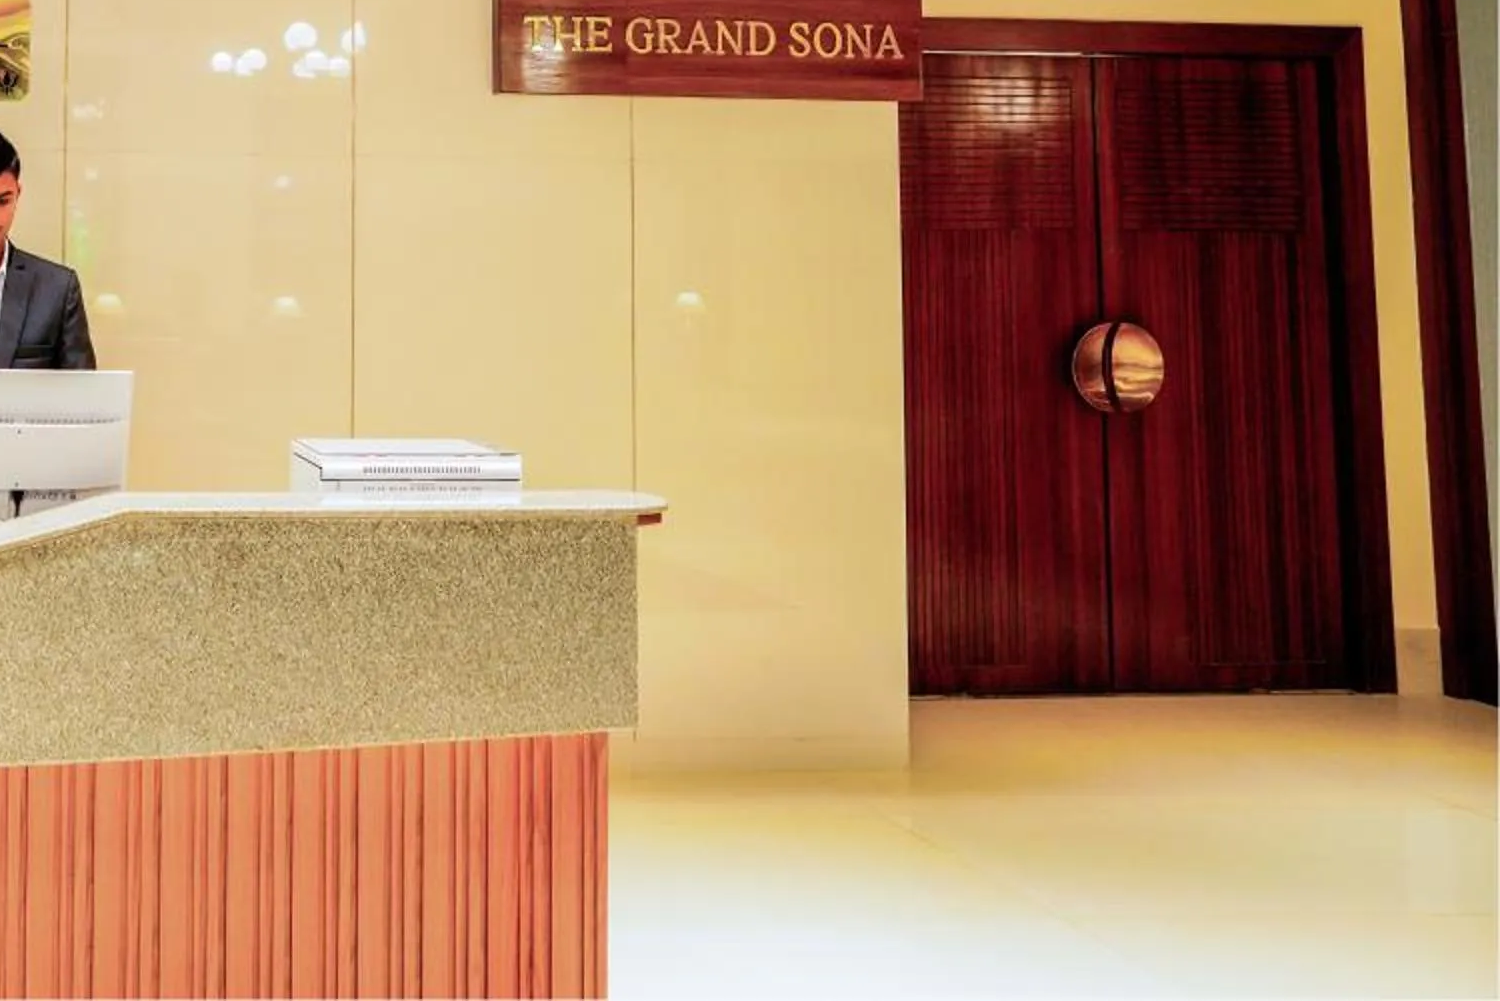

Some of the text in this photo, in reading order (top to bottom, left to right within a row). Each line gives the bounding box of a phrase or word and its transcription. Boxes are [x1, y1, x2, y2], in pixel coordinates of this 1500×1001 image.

[523, 15, 904, 59] THE GRAND SONA
